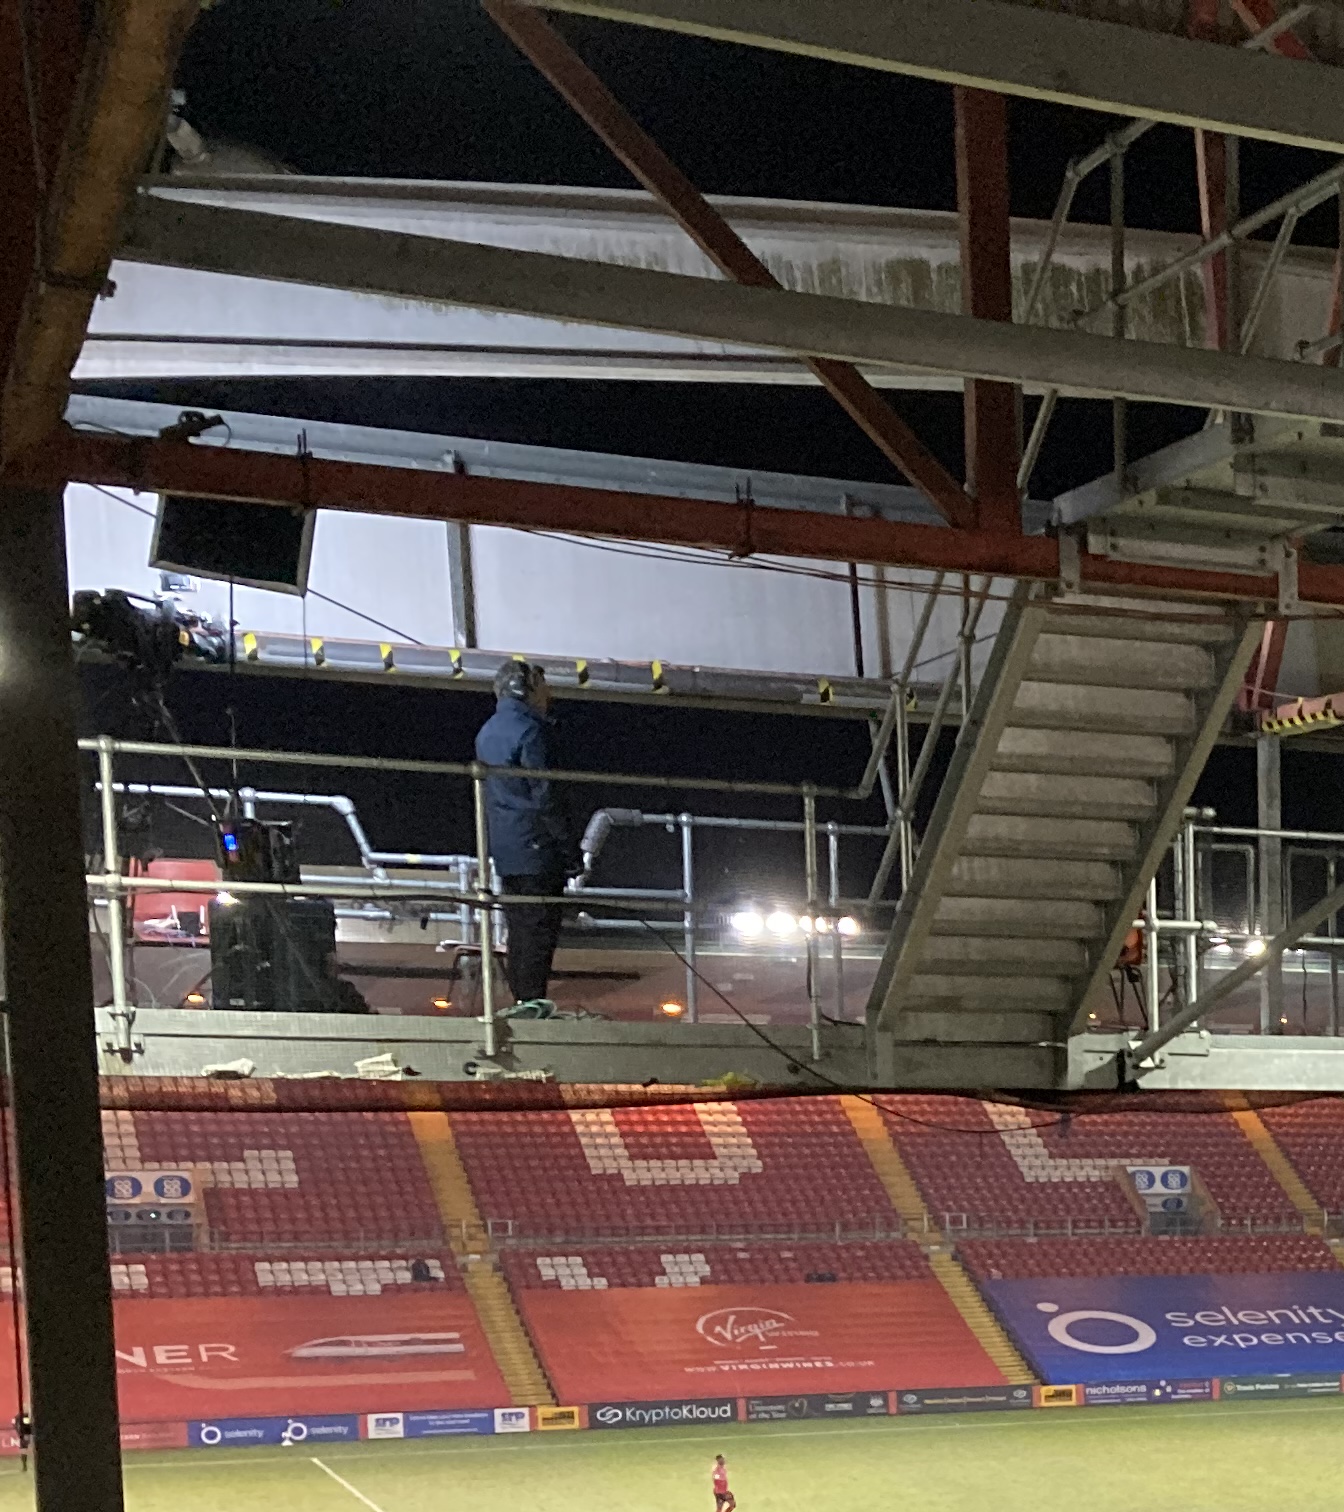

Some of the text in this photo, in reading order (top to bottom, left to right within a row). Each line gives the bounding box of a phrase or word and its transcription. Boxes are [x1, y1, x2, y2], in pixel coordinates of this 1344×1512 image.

[713, 1315, 785, 1343] Virgin
[114, 1344, 240, 1368] NER
[1085, 1384, 1147, 1395] nicholsons
[625, 1403, 731, 1425] KryptoKloud
